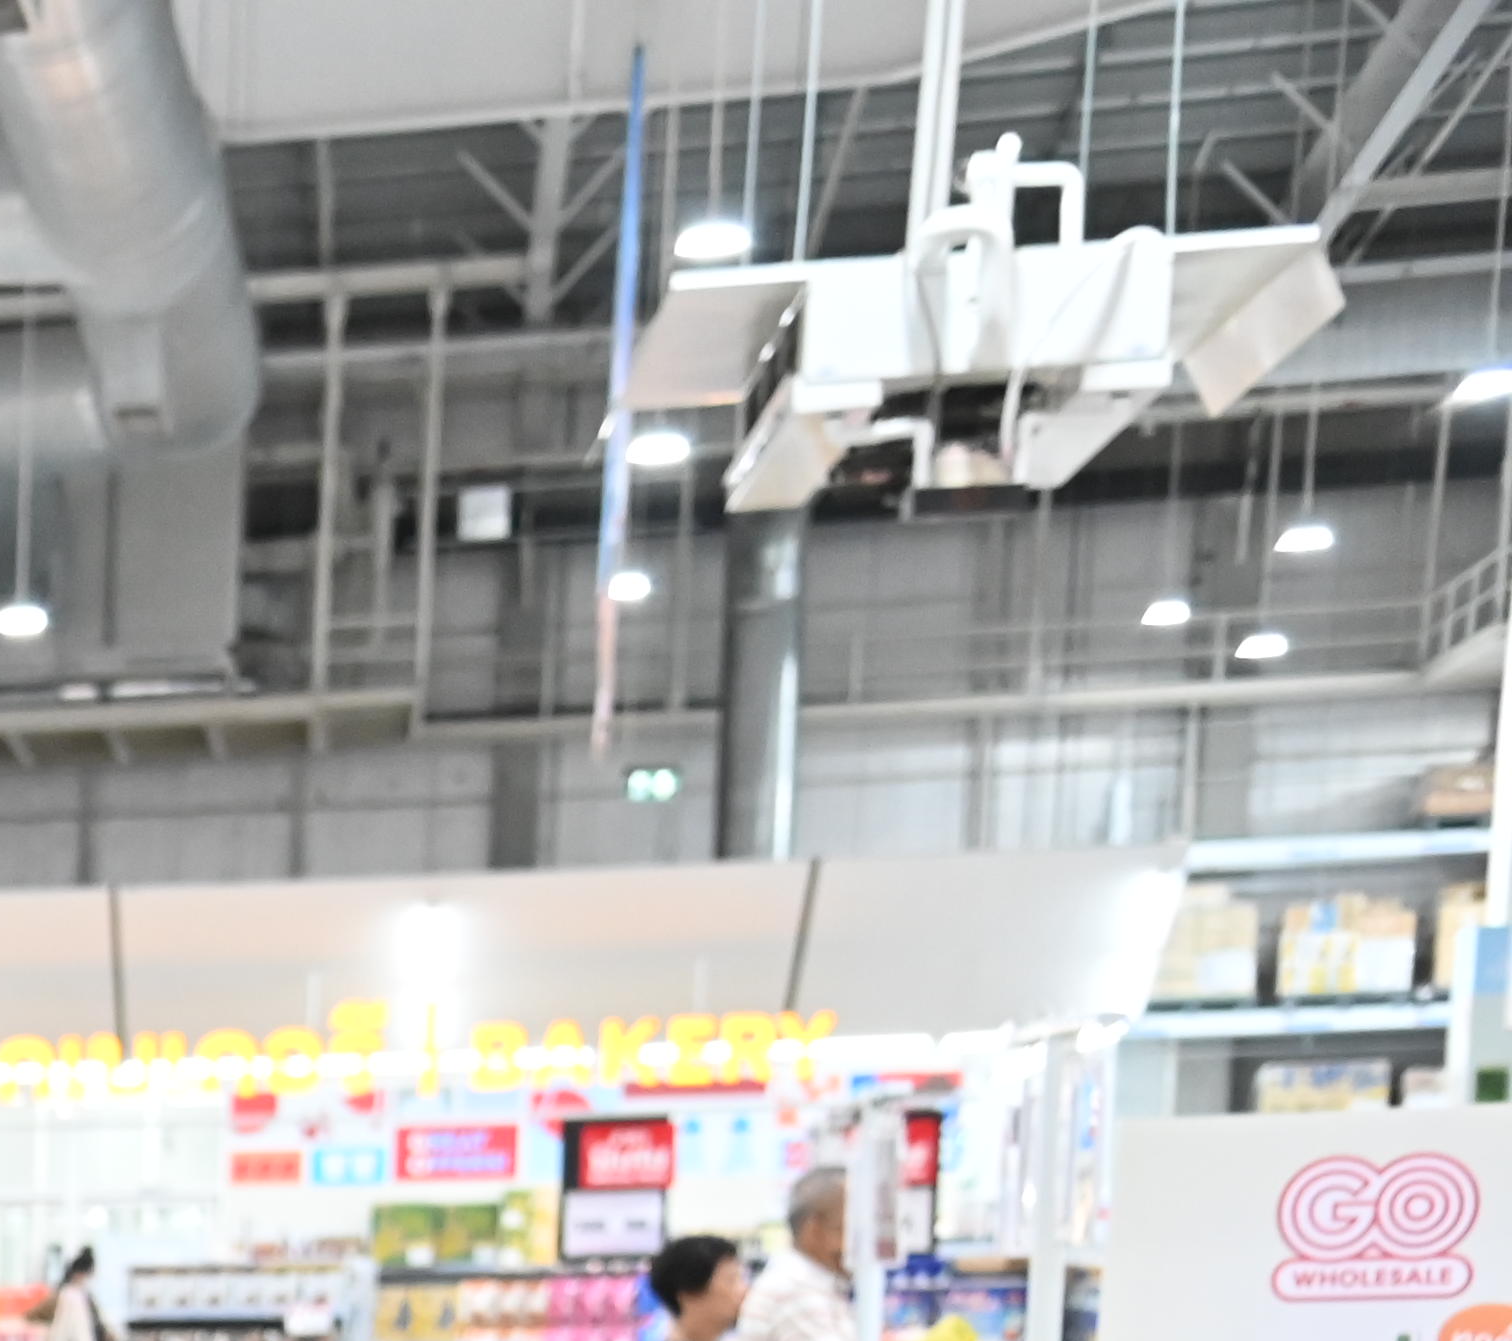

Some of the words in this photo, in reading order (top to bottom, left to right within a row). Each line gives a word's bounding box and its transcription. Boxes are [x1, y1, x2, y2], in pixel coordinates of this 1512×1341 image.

[469, 1009, 837, 1091] BAKERY
[1277, 1151, 1480, 1263] GO
[1294, 1267, 1453, 1288] WHOLESALE
